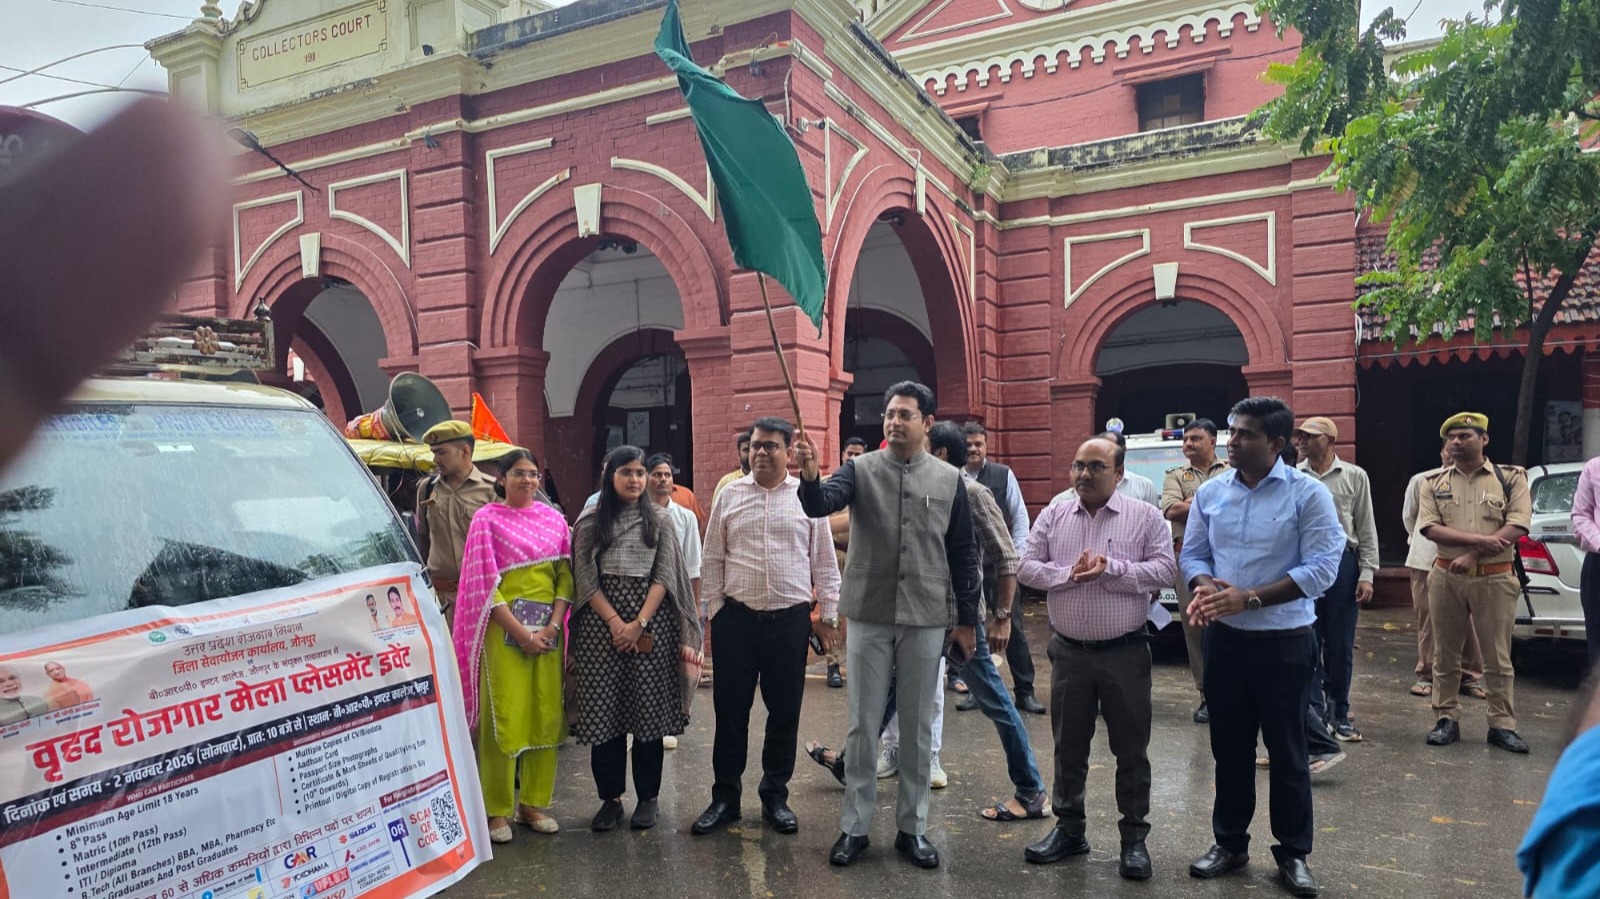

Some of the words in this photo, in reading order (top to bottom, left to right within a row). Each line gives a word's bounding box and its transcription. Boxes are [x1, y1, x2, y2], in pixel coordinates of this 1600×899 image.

[252, 28, 328, 61] COLLECTORS
[331, 14, 372, 38] COURT
[172, 655, 199, 676] जिला
[200, 646, 245, 669] सेवायोजन
[290, 632, 317, 653] जौनपुर
[25, 723, 104, 783] वृहद
[106, 694, 224, 748] रोजगार
[225, 677, 288, 713] मेला
[289, 650, 374, 694] प्लेसमेंट
[376, 642, 412, 676] इवेंट
[295, 745, 322, 760] Multiple
[323, 737, 343, 751] Copies
[297, 754, 324, 770] Aadhaar
[324, 748, 339, 760] Card
[299, 763, 328, 781] Passport
[328, 759, 342, 771] Size
[342, 746, 378, 766] Photographs
[3, 798, 50, 825] दिनांक
[52, 788, 68, 808] एवं
[69, 782, 103, 802] समय
[113, 774, 122, 788] 2
[124, 761, 166, 786] नवम्बर
[166, 752, 195, 771] 2026
[266, 726, 278, 741] 10
[126, 789, 144, 802] WHO
[144, 784, 158, 797] CAN
[158, 773, 196, 791] PARTICIPATE
[301, 773, 335, 791] Certificate
[335, 769, 342, 778] &
[319, 779, 350, 795] Onwards)
[304, 795, 332, 812] Printout
[336, 786, 358, 800] Digital
[357, 780, 372, 793] Copy
[65, 815, 115, 838] Minimum
[117, 809, 135, 824] Age
[137, 799, 161, 815] Limit
[163, 794, 174, 806] 18
[174, 786, 199, 803] Years
[72, 844, 107, 864] Matric
[108, 834, 131, 853] (10th
[132, 824, 160, 842] Pass)
[82, 831, 108, 847] Pass
[350, 821, 377, 840] SUZUKI
[390, 823, 406, 838] OR
[418, 830, 440, 849] CODE
[76, 847, 135, 876] Intermediate
[137, 837, 162, 854] (12th
[162, 826, 188, 843] Pass)
[112, 872, 128, 888] (All
[130, 854, 176, 880] Branches)
[177, 847, 199, 863] BBA,
[201, 837, 224, 853] MBA,
[225, 822, 264, 844] Pharmacy
[161, 887, 175, 899] 60
[178, 878, 190, 894] से
[193, 867, 225, 888] अधिक
[227, 845, 270, 874] कम्पनियों
[341, 815, 354, 828] पर
[284, 845, 318, 869] GMR
[79, 875, 92, 889] ITI
[100, 859, 137, 880] Diploma
[108, 876, 155, 899] Graduates
[157, 867, 174, 883] And
[175, 861, 196, 878] Post
[197, 843, 239, 865] Graduates
[293, 861, 329, 883] YOKOHAMA
